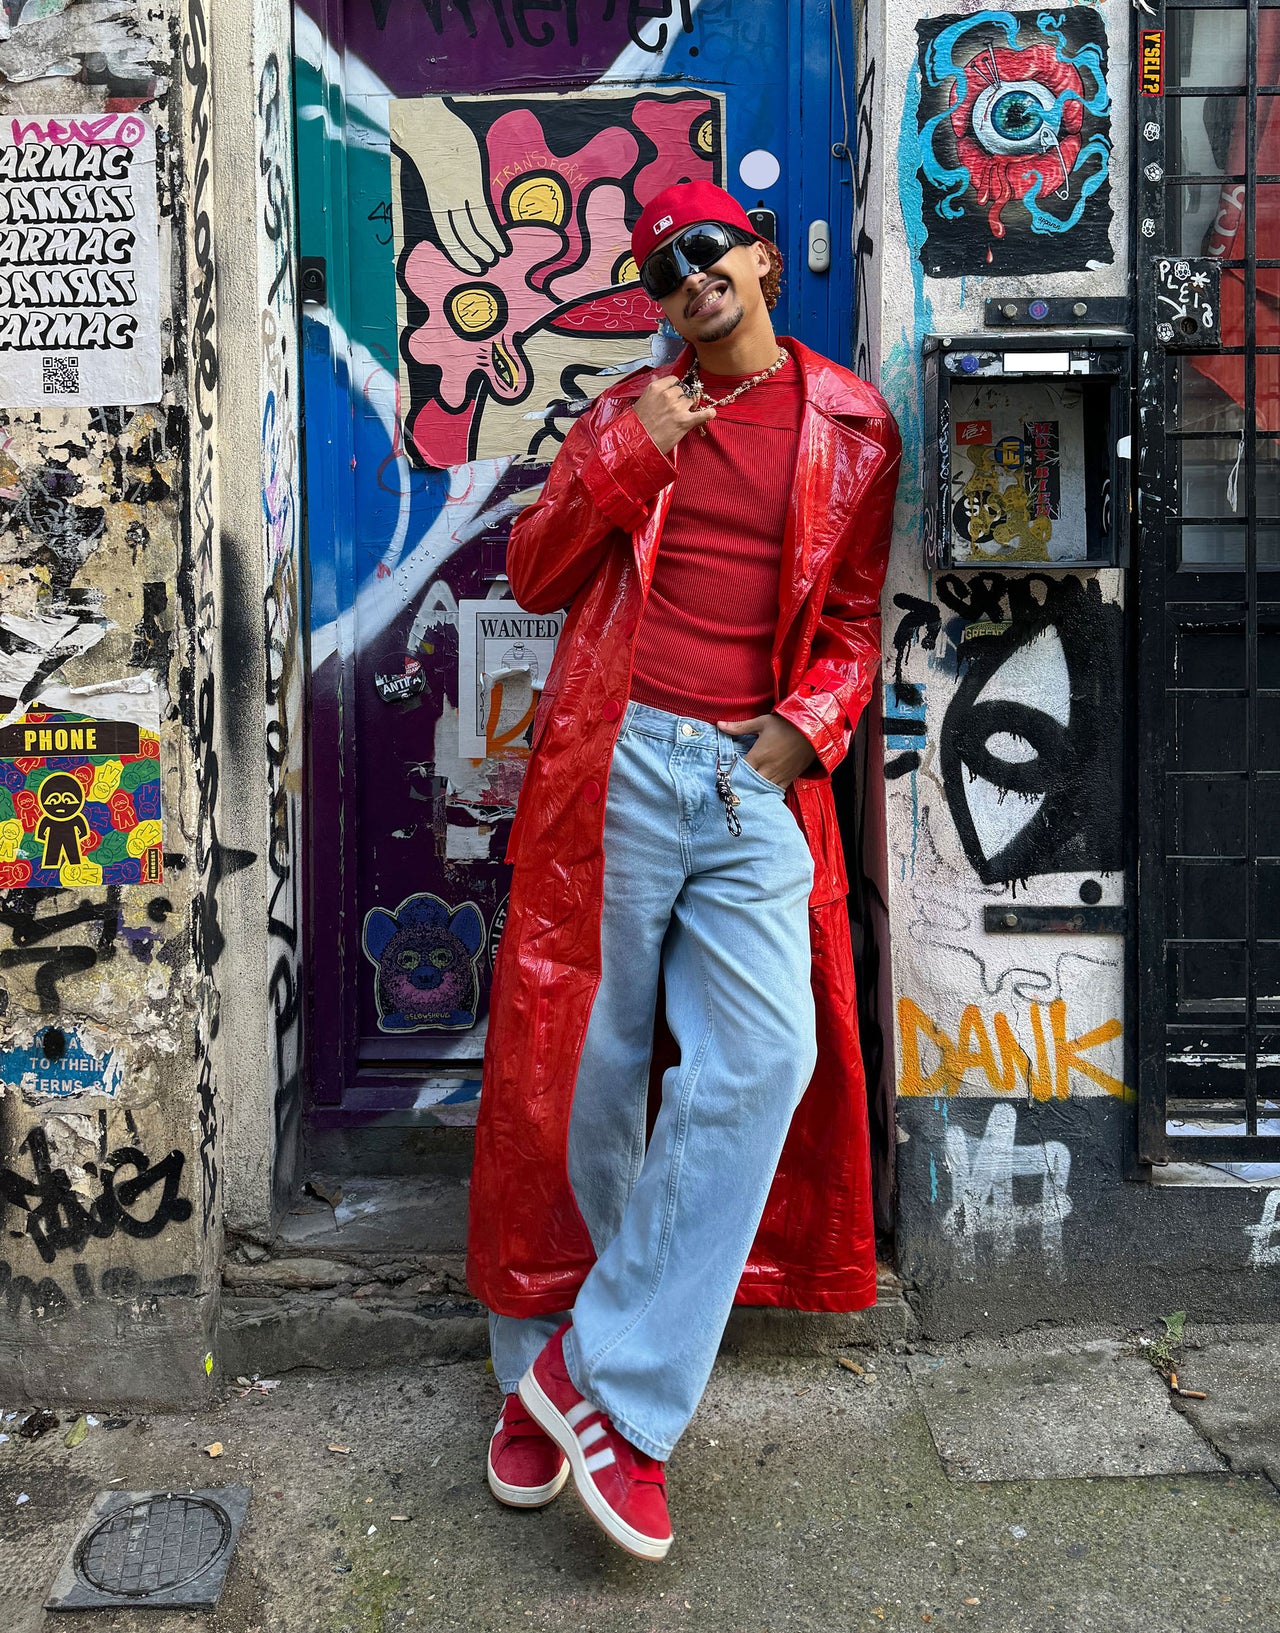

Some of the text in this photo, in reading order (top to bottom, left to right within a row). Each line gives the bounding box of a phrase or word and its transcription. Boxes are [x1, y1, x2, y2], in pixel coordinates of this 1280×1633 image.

[1143, 32, 1161, 93] Y'SELF?
[492, 151, 589, 190] TRANSFORM
[0, 226, 136, 266] ARMAC
[0, 311, 139, 351] ARMAC
[479, 619, 560, 638] WANTED
[23, 728, 97, 752] PHONE
[29, 1057, 105, 1072] TO THEIR
[898, 996, 1138, 1102] DANK
[31, 1079, 83, 1093] TERMS
